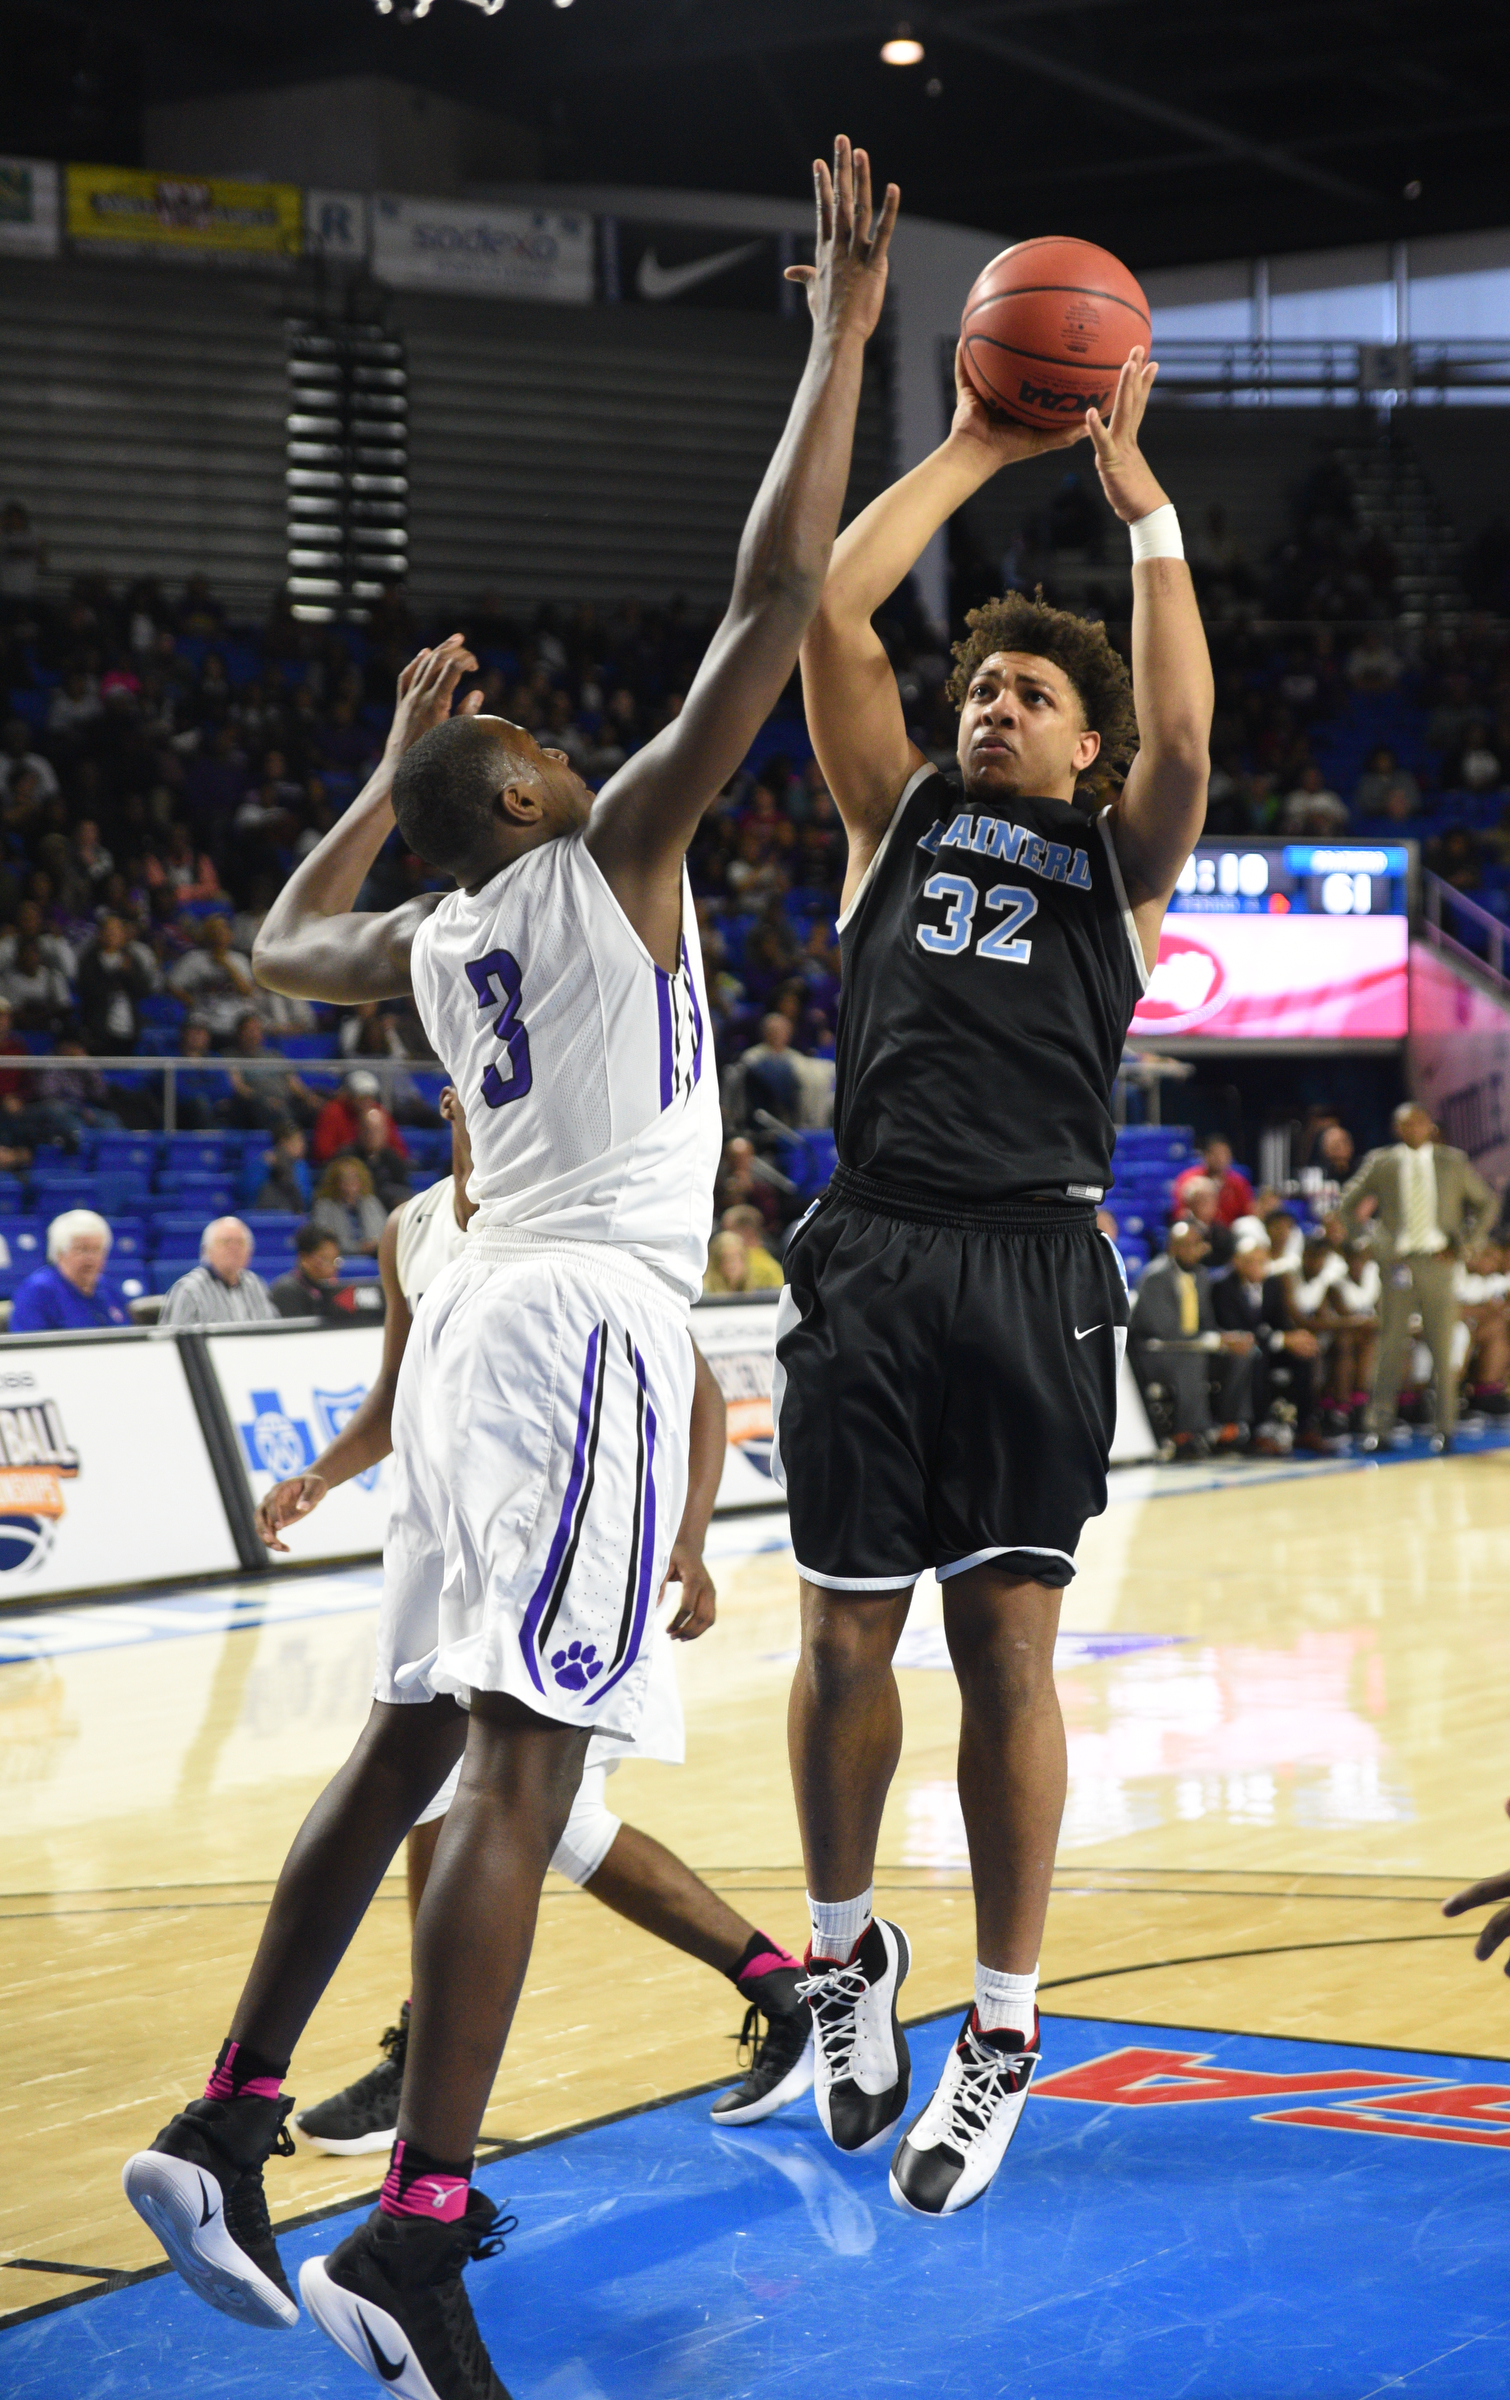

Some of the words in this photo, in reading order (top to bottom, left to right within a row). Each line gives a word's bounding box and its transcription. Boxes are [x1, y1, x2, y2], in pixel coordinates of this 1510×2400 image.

[1018, 380, 1110, 413] NCAA
[916, 871, 1039, 965] 32
[464, 948, 533, 1109] 3
[0, 1401, 78, 1465] BALL
